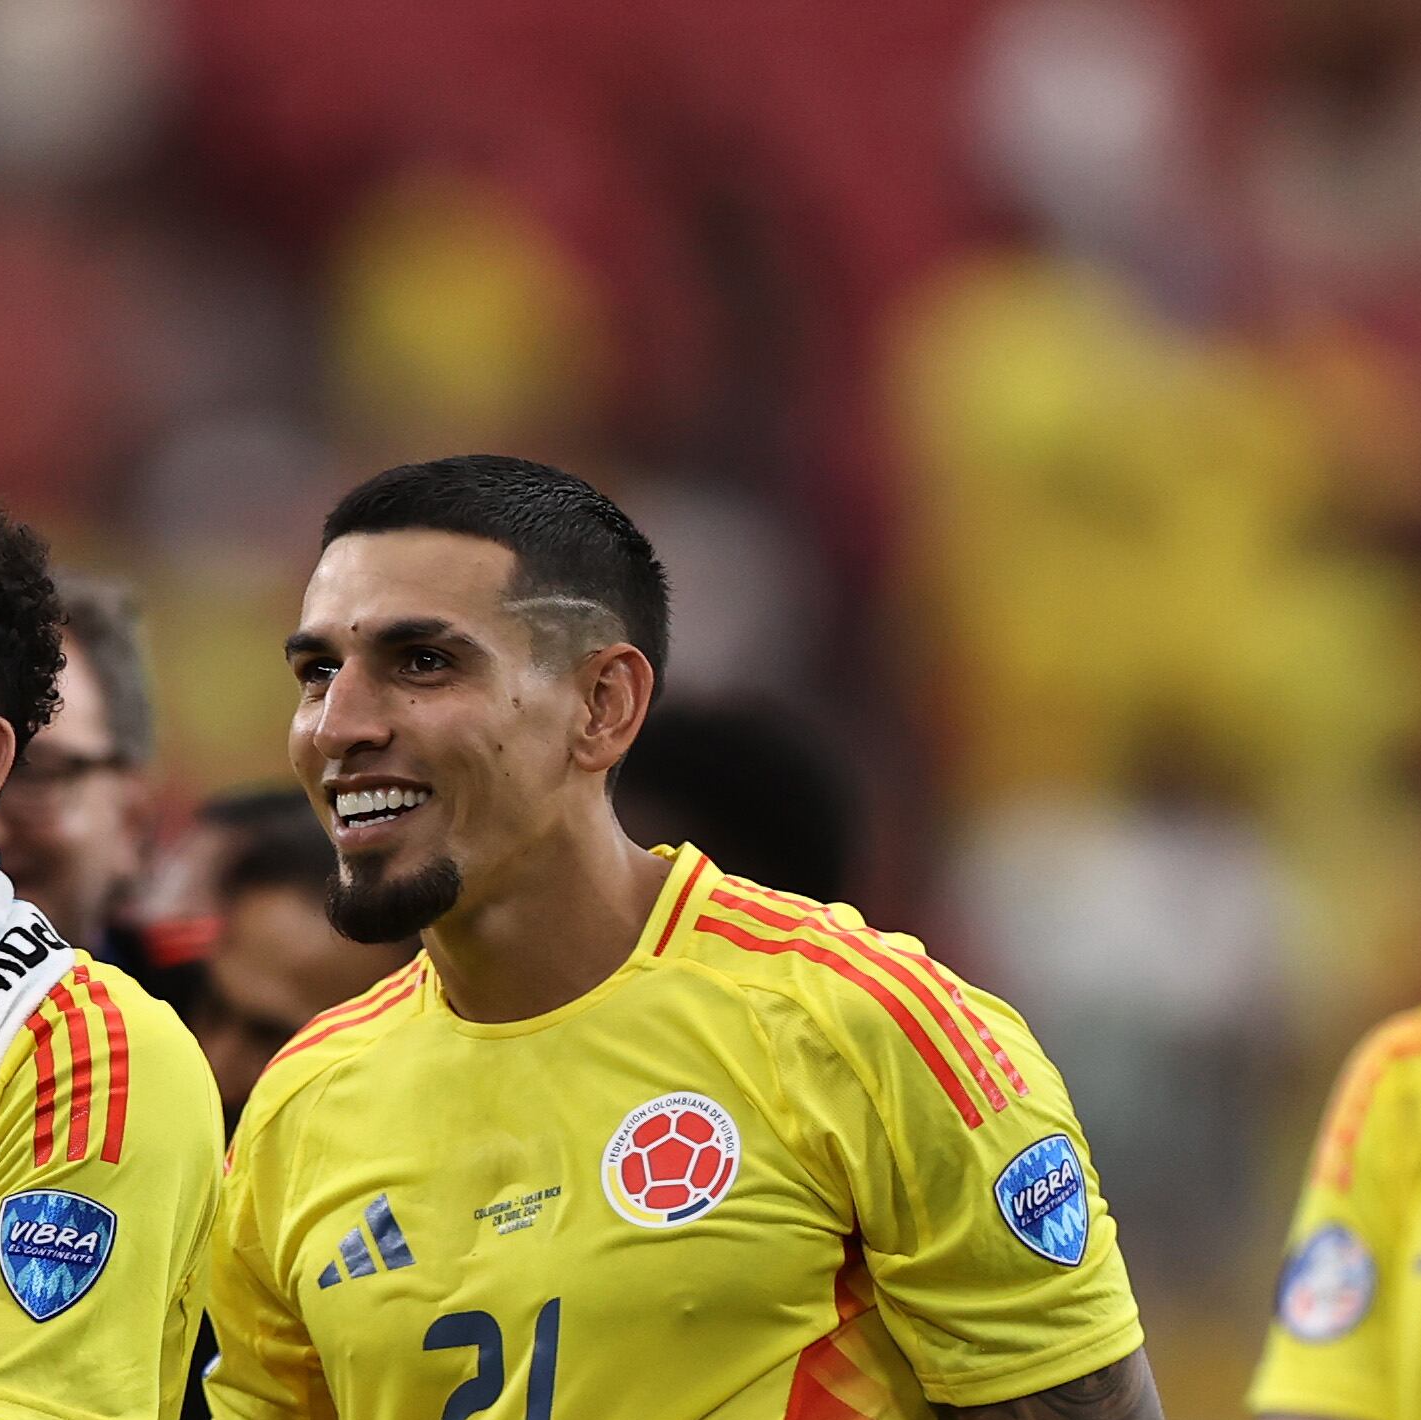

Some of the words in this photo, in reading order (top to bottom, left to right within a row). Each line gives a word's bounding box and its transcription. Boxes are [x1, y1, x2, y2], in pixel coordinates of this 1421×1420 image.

[647, 1097, 711, 1114] COLOMBIANA
[709, 1109, 723, 1121] DE
[1013, 1160, 1074, 1216] VIBRA
[1021, 1214, 1032, 1227] EL
[1033, 1182, 1077, 1219] CONTINENTE
[10, 1221, 98, 1253] VIBRA
[8, 1243, 21, 1253] EL
[23, 1245, 94, 1264] CONTINENTE
